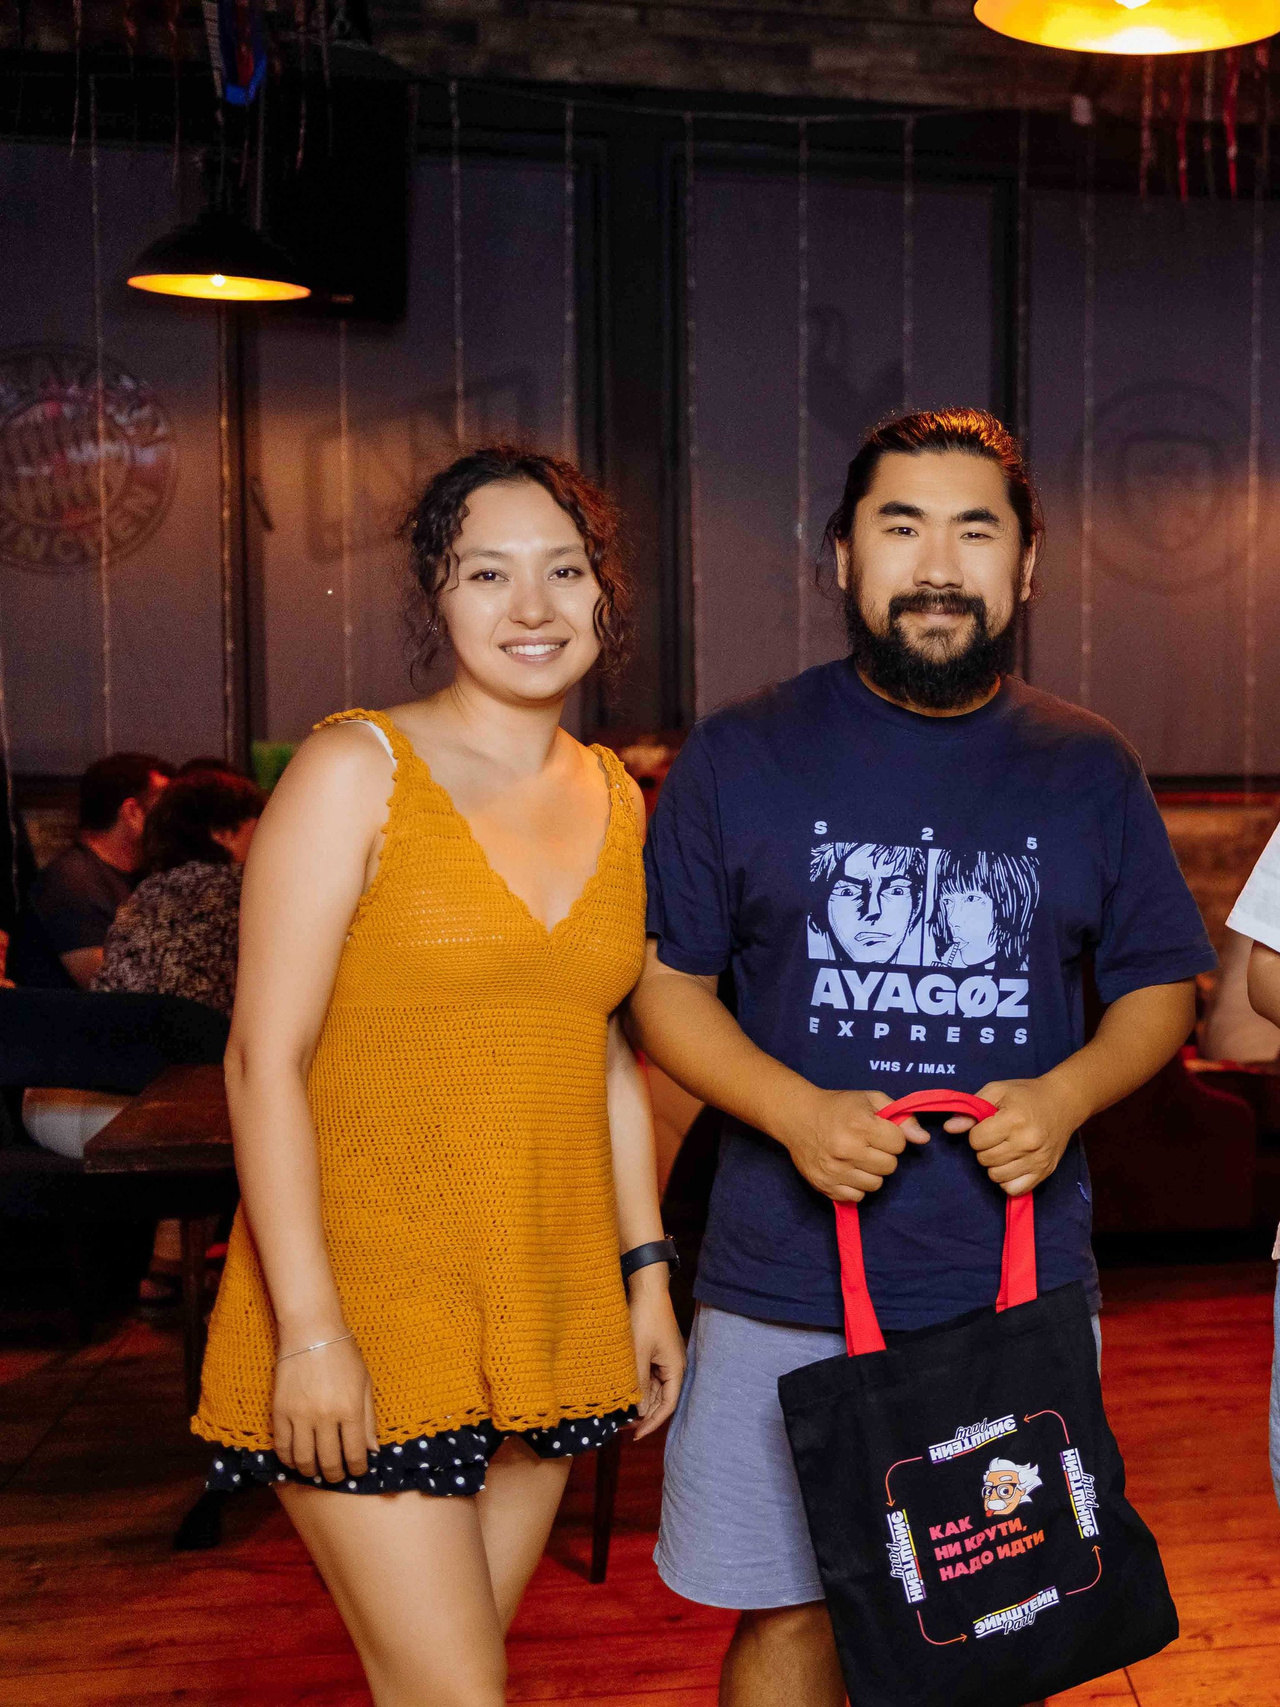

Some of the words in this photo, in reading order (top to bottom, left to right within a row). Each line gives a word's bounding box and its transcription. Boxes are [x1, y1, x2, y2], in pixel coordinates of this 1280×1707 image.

[810, 967, 1030, 1019] AYAGØZ
[809, 1017, 1028, 1045] EXPRESS
[869, 1060, 901, 1072] VHS
[918, 1063, 956, 1074] IMAX
[955, 1417, 988, 1440] Party
[1081, 1473, 1100, 1508] Party
[929, 1516, 973, 1541] КАК
[934, 1542, 962, 1561] НИ
[964, 1517, 1027, 1553] КРУТИ,
[889, 1542, 904, 1578] Party
[939, 1551, 994, 1582] НАДО
[996, 1530, 1045, 1560] ИДТИ
[1003, 1611, 1036, 1635] Party
